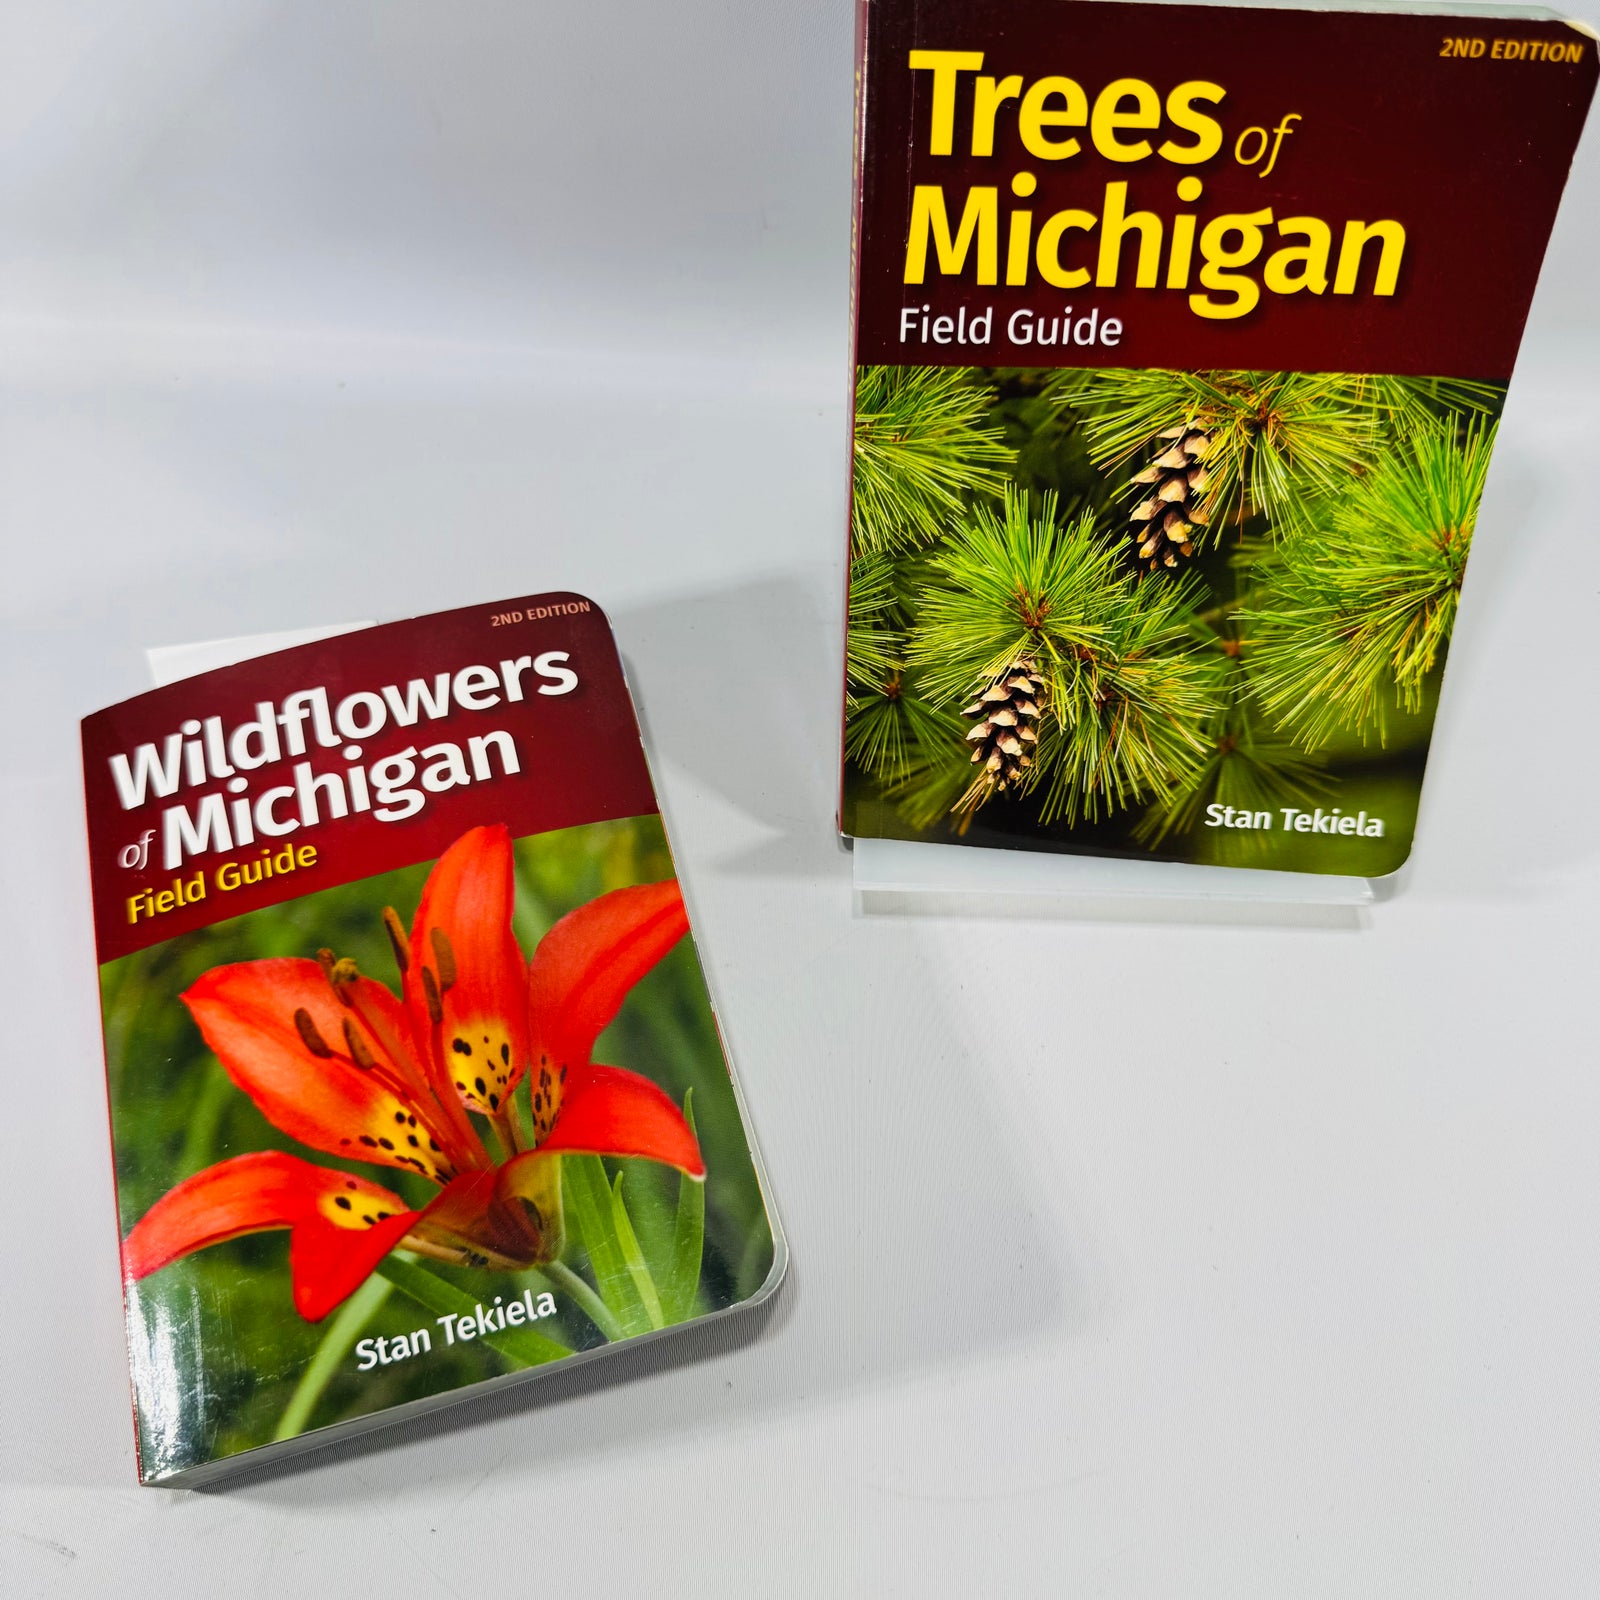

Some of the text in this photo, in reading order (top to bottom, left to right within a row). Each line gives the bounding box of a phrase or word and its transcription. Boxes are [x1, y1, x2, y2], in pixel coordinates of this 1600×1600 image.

[1439, 38, 1583, 64] 2ND EDITION
[909, 50, 1302, 178] Trees of
[903, 171, 1406, 320] Michigan
[899, 304, 1123, 347] Field Guide
[490, 601, 592, 628] 2ND EDITION
[108, 651, 579, 810] Wildflowers
[117, 728, 521, 871] of Michigan
[1203, 803, 1385, 838] Stan Tekiela
[125, 842, 318, 925] Field Guide
[355, 1288, 558, 1372] Stan Tekiela
